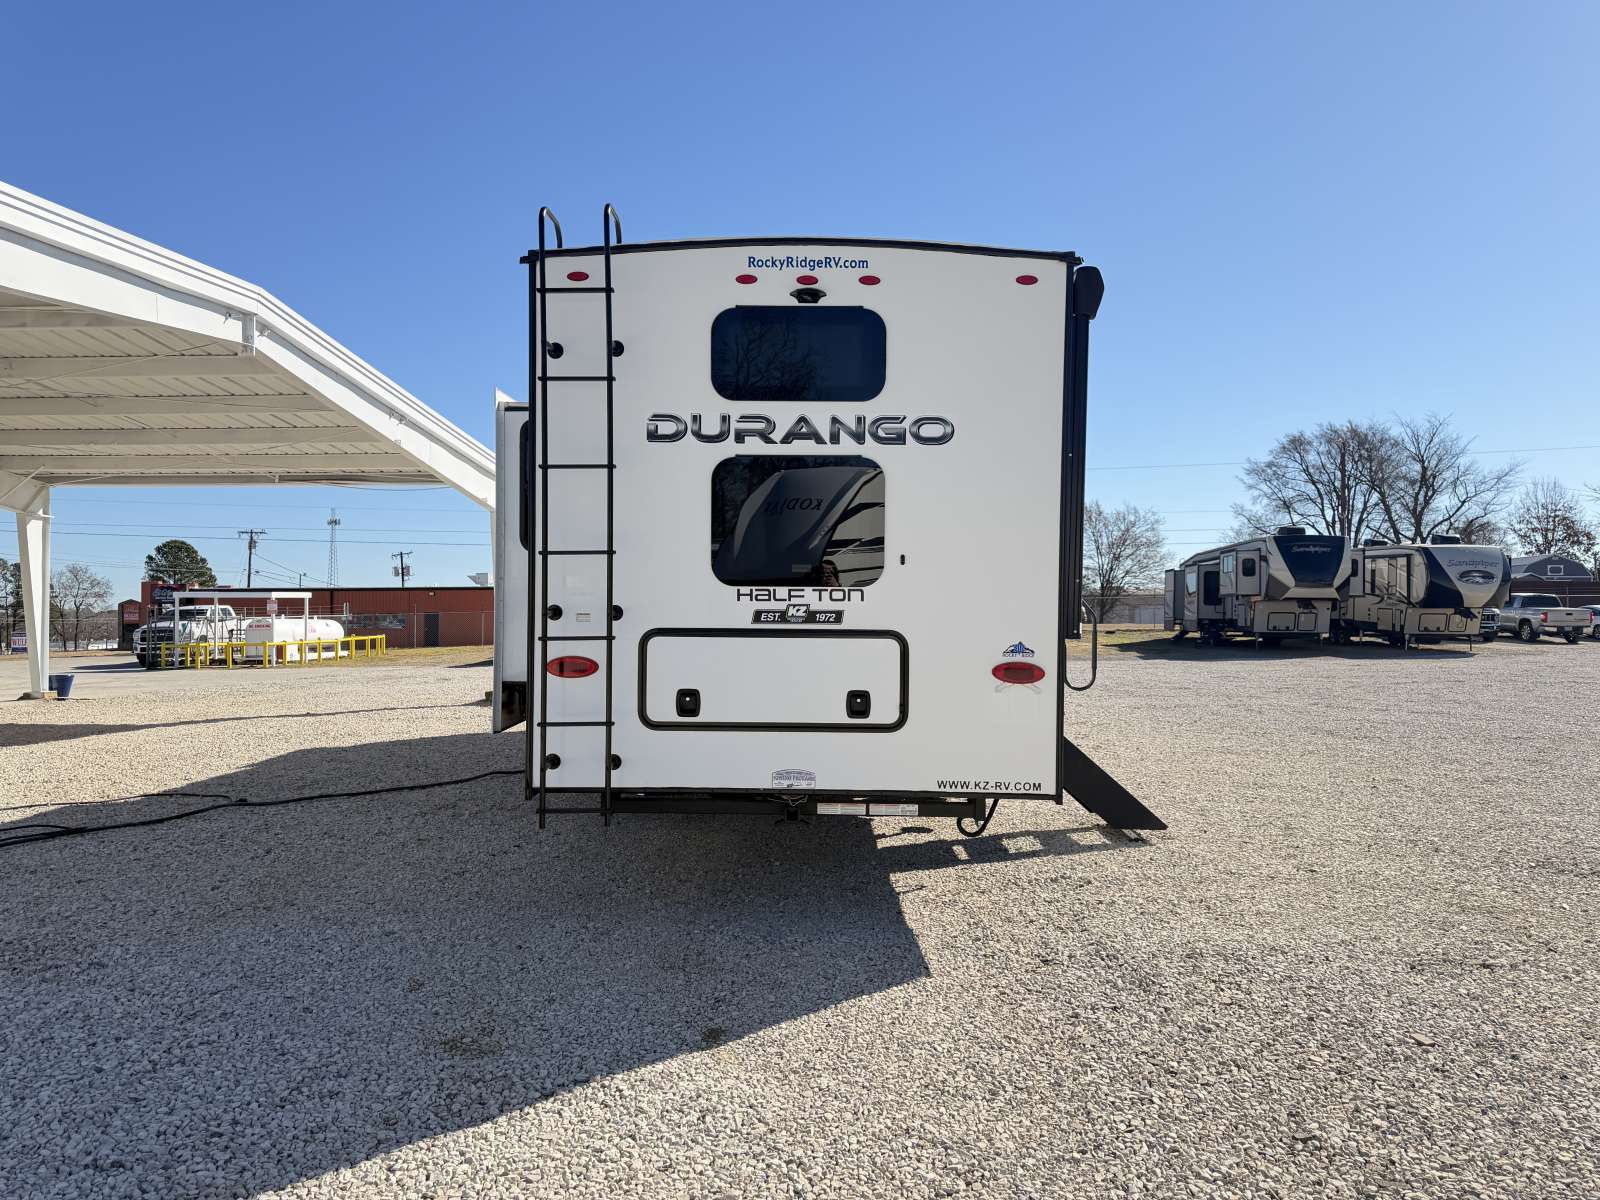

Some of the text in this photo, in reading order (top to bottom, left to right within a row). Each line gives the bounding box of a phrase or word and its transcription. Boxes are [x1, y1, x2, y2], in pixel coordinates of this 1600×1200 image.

[748, 256, 869, 271] RockyRidgeRV.com
[646, 412, 955, 446] DURANGO
[760, 612, 781, 622] EST.
[786, 605, 807, 617] KZ
[815, 613, 836, 622] 1972
[937, 780, 1042, 791] WWW.KZ-RV.COM
